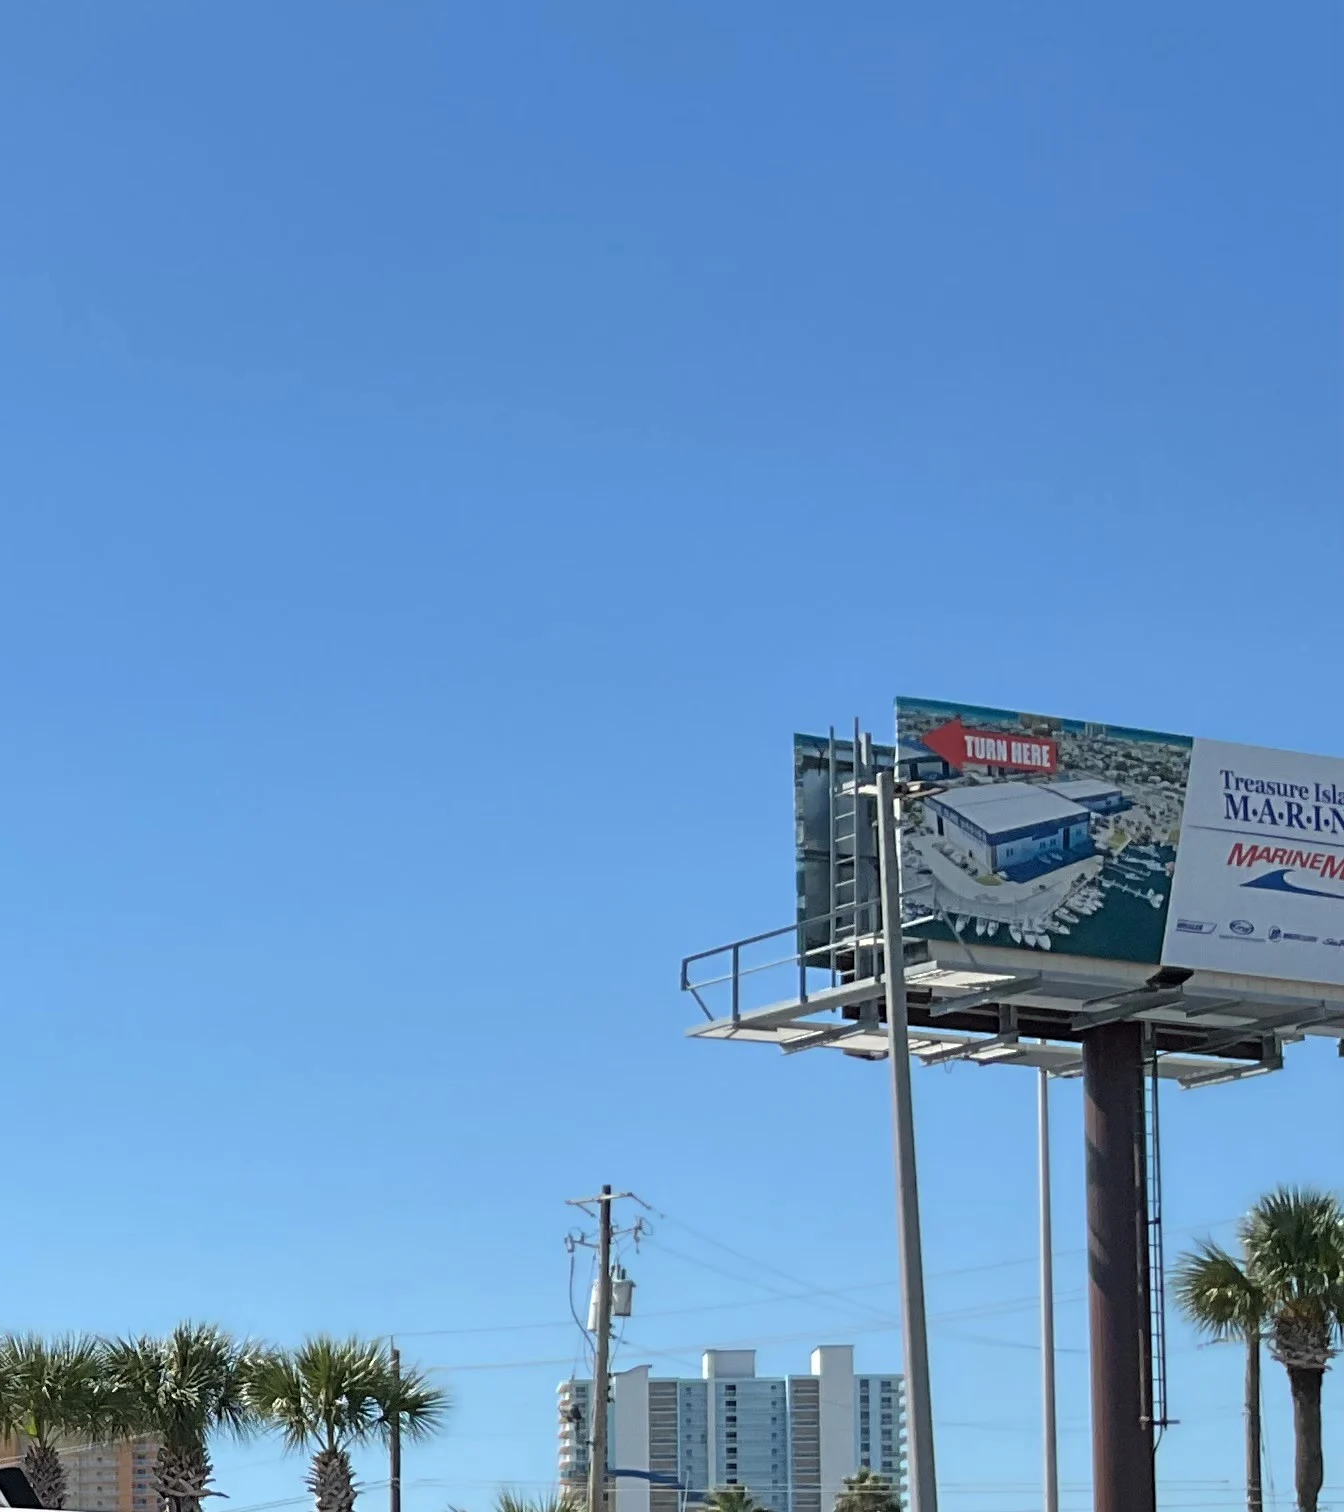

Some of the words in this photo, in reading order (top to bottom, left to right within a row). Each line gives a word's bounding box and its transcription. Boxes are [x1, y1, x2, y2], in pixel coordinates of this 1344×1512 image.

[964, 735, 1008, 762] TURN
[1011, 741, 1051, 768] HERE
[1219, 769, 1310, 801] Treasure
